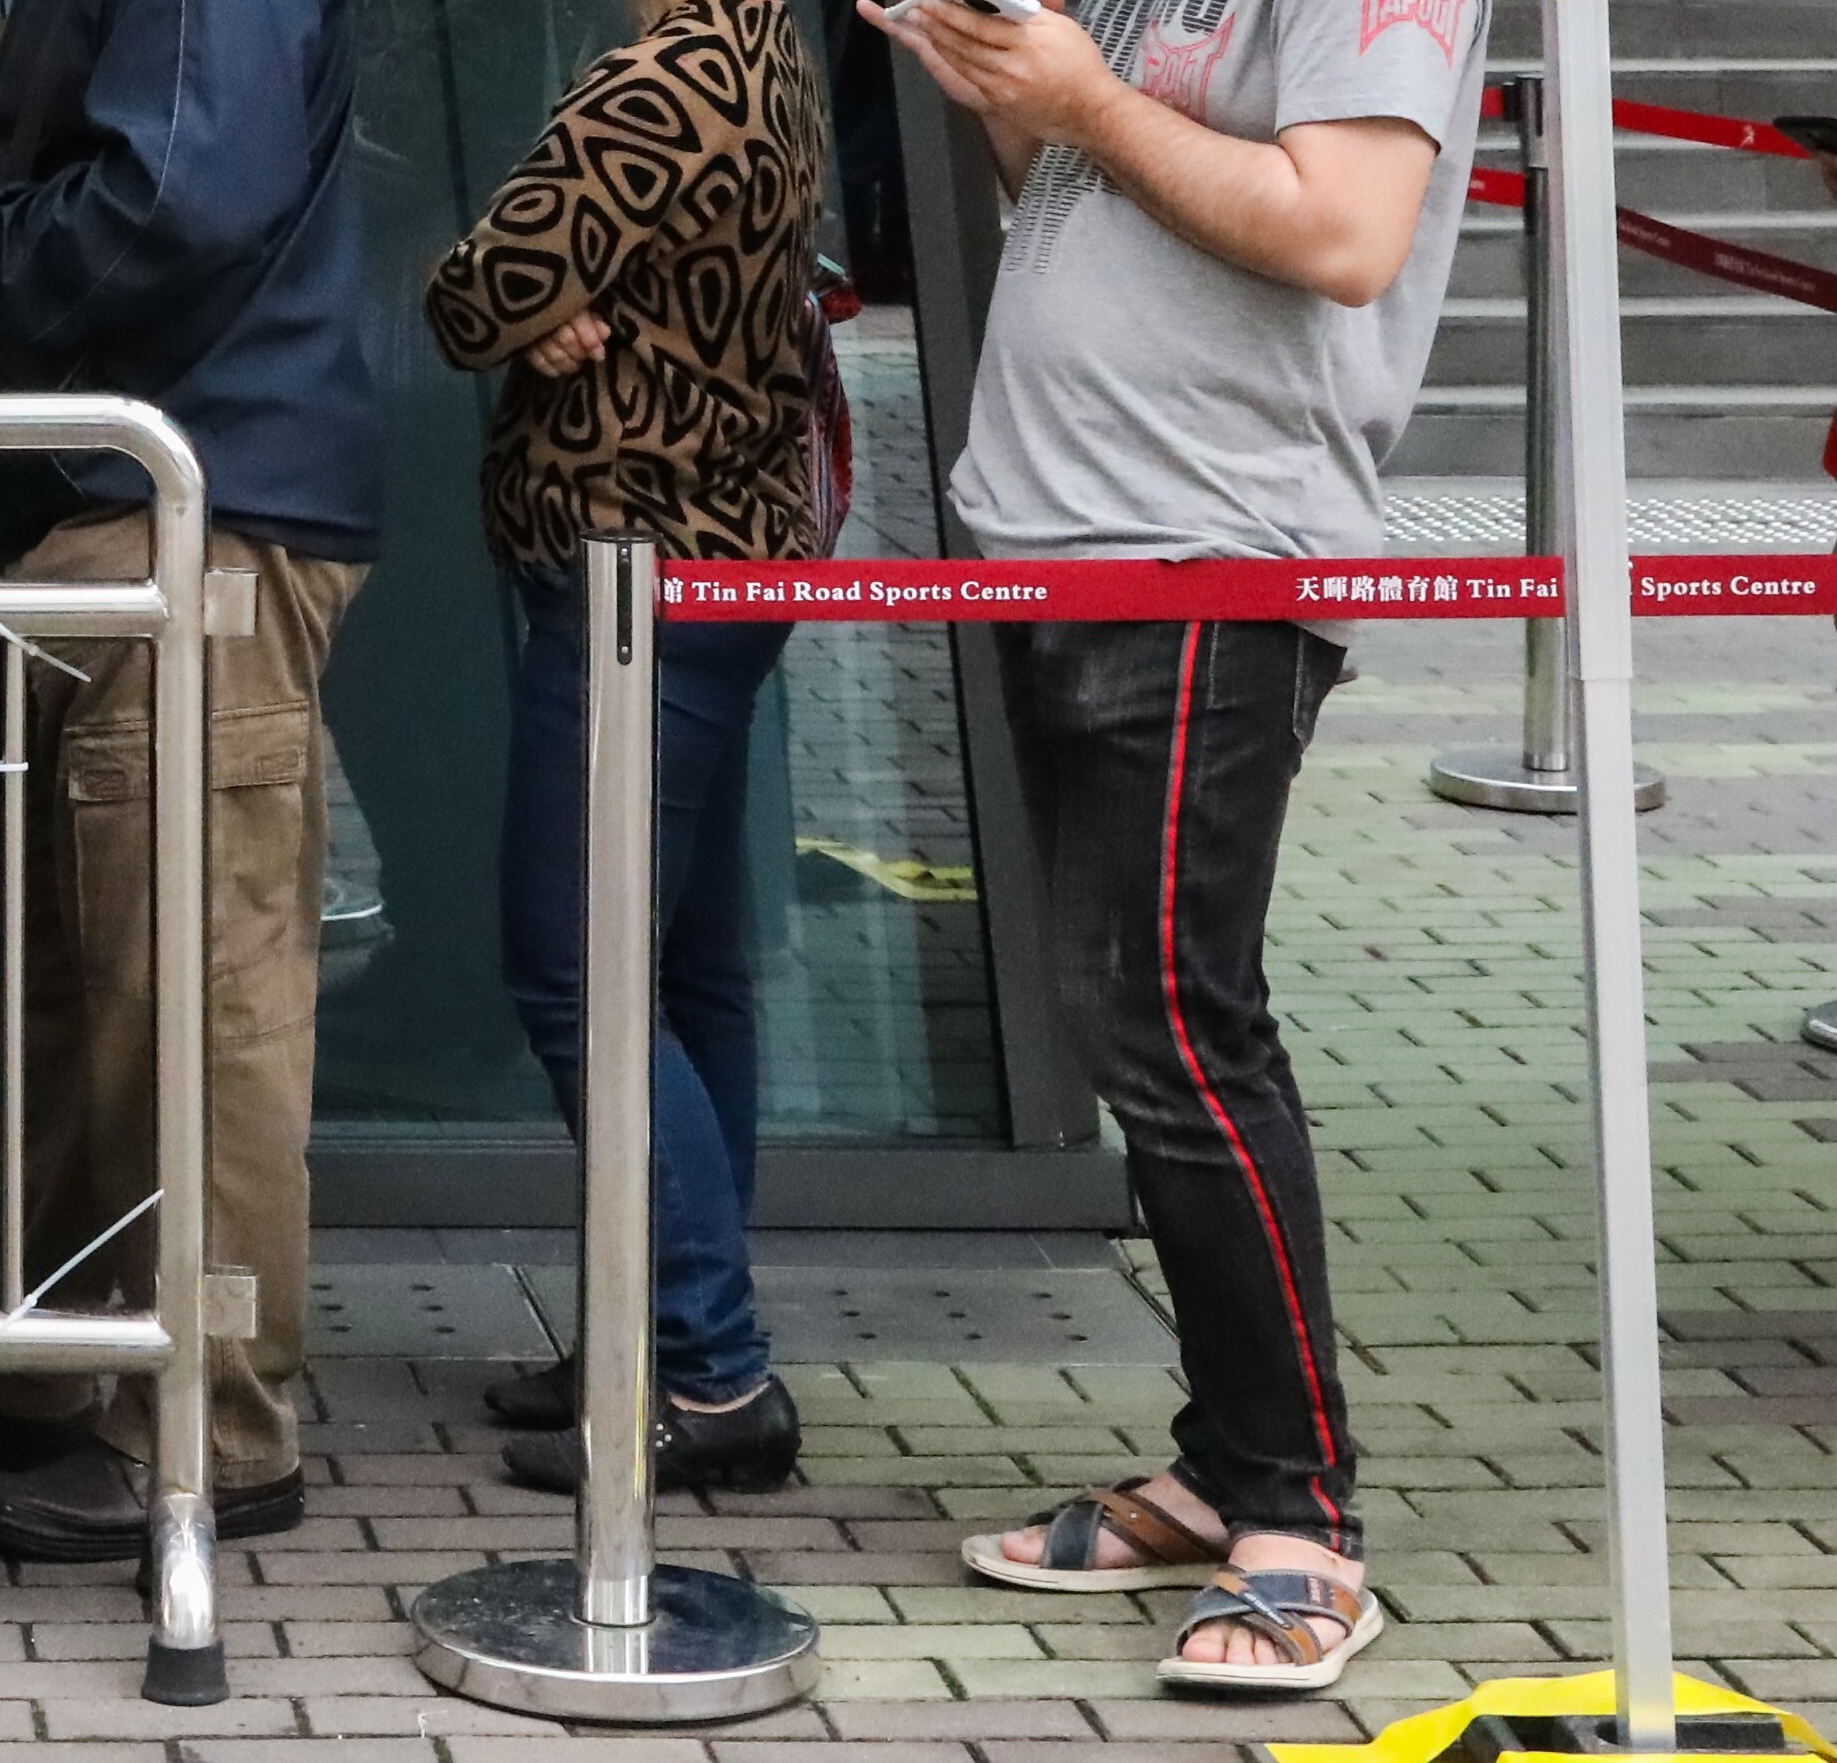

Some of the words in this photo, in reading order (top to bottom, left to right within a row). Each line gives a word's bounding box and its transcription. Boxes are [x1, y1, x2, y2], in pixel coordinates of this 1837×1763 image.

[663, 576, 684, 604] 館
[691, 581, 738, 602] Tin
[745, 581, 786, 602] Fai
[792, 580, 862, 602] Road
[869, 581, 952, 607] Sports
[960, 580, 1047, 601] Centre
[1296, 574, 1459, 602] 天暉路體育館
[1466, 578, 1511, 599] Tin
[1519, 577, 1559, 598] Fai
[1641, 576, 1722, 602] Sports
[1730, 575, 1816, 596] Centre
